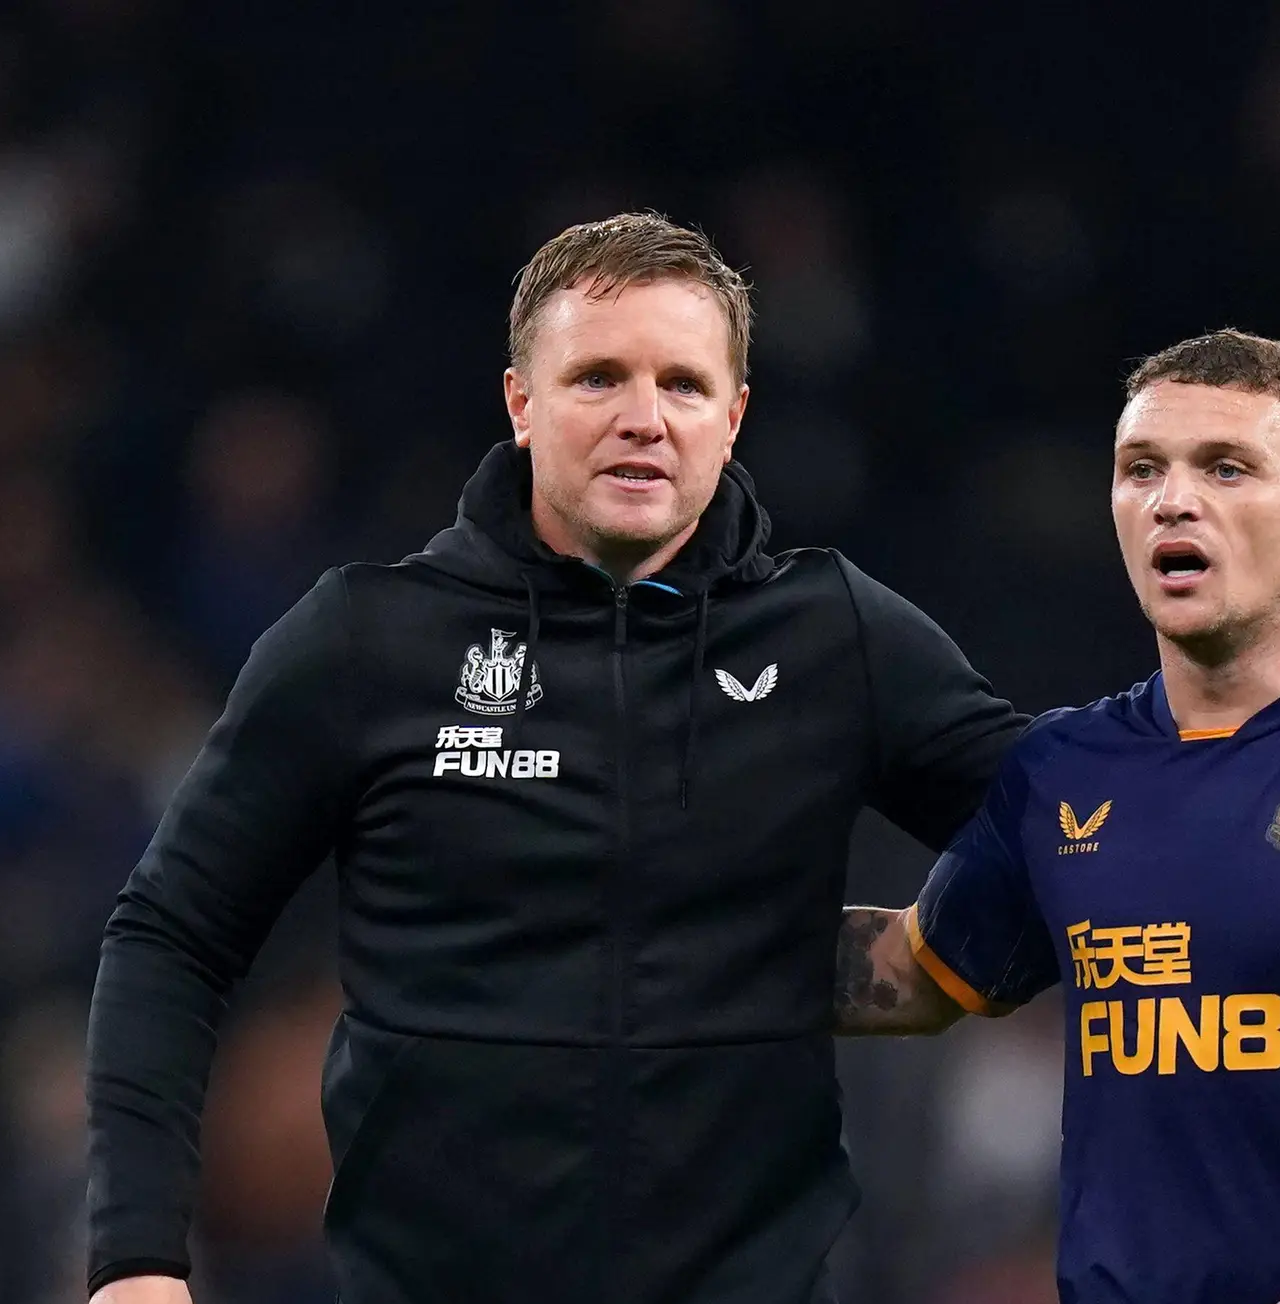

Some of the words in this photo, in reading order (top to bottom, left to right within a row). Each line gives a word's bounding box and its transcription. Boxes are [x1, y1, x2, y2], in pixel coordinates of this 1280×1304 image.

[435, 725, 503, 749] 乐天堂
[432, 749, 560, 779] FUN88
[1058, 841, 1100, 856] CASTORE
[1066, 917, 1192, 990] 乐天堂
